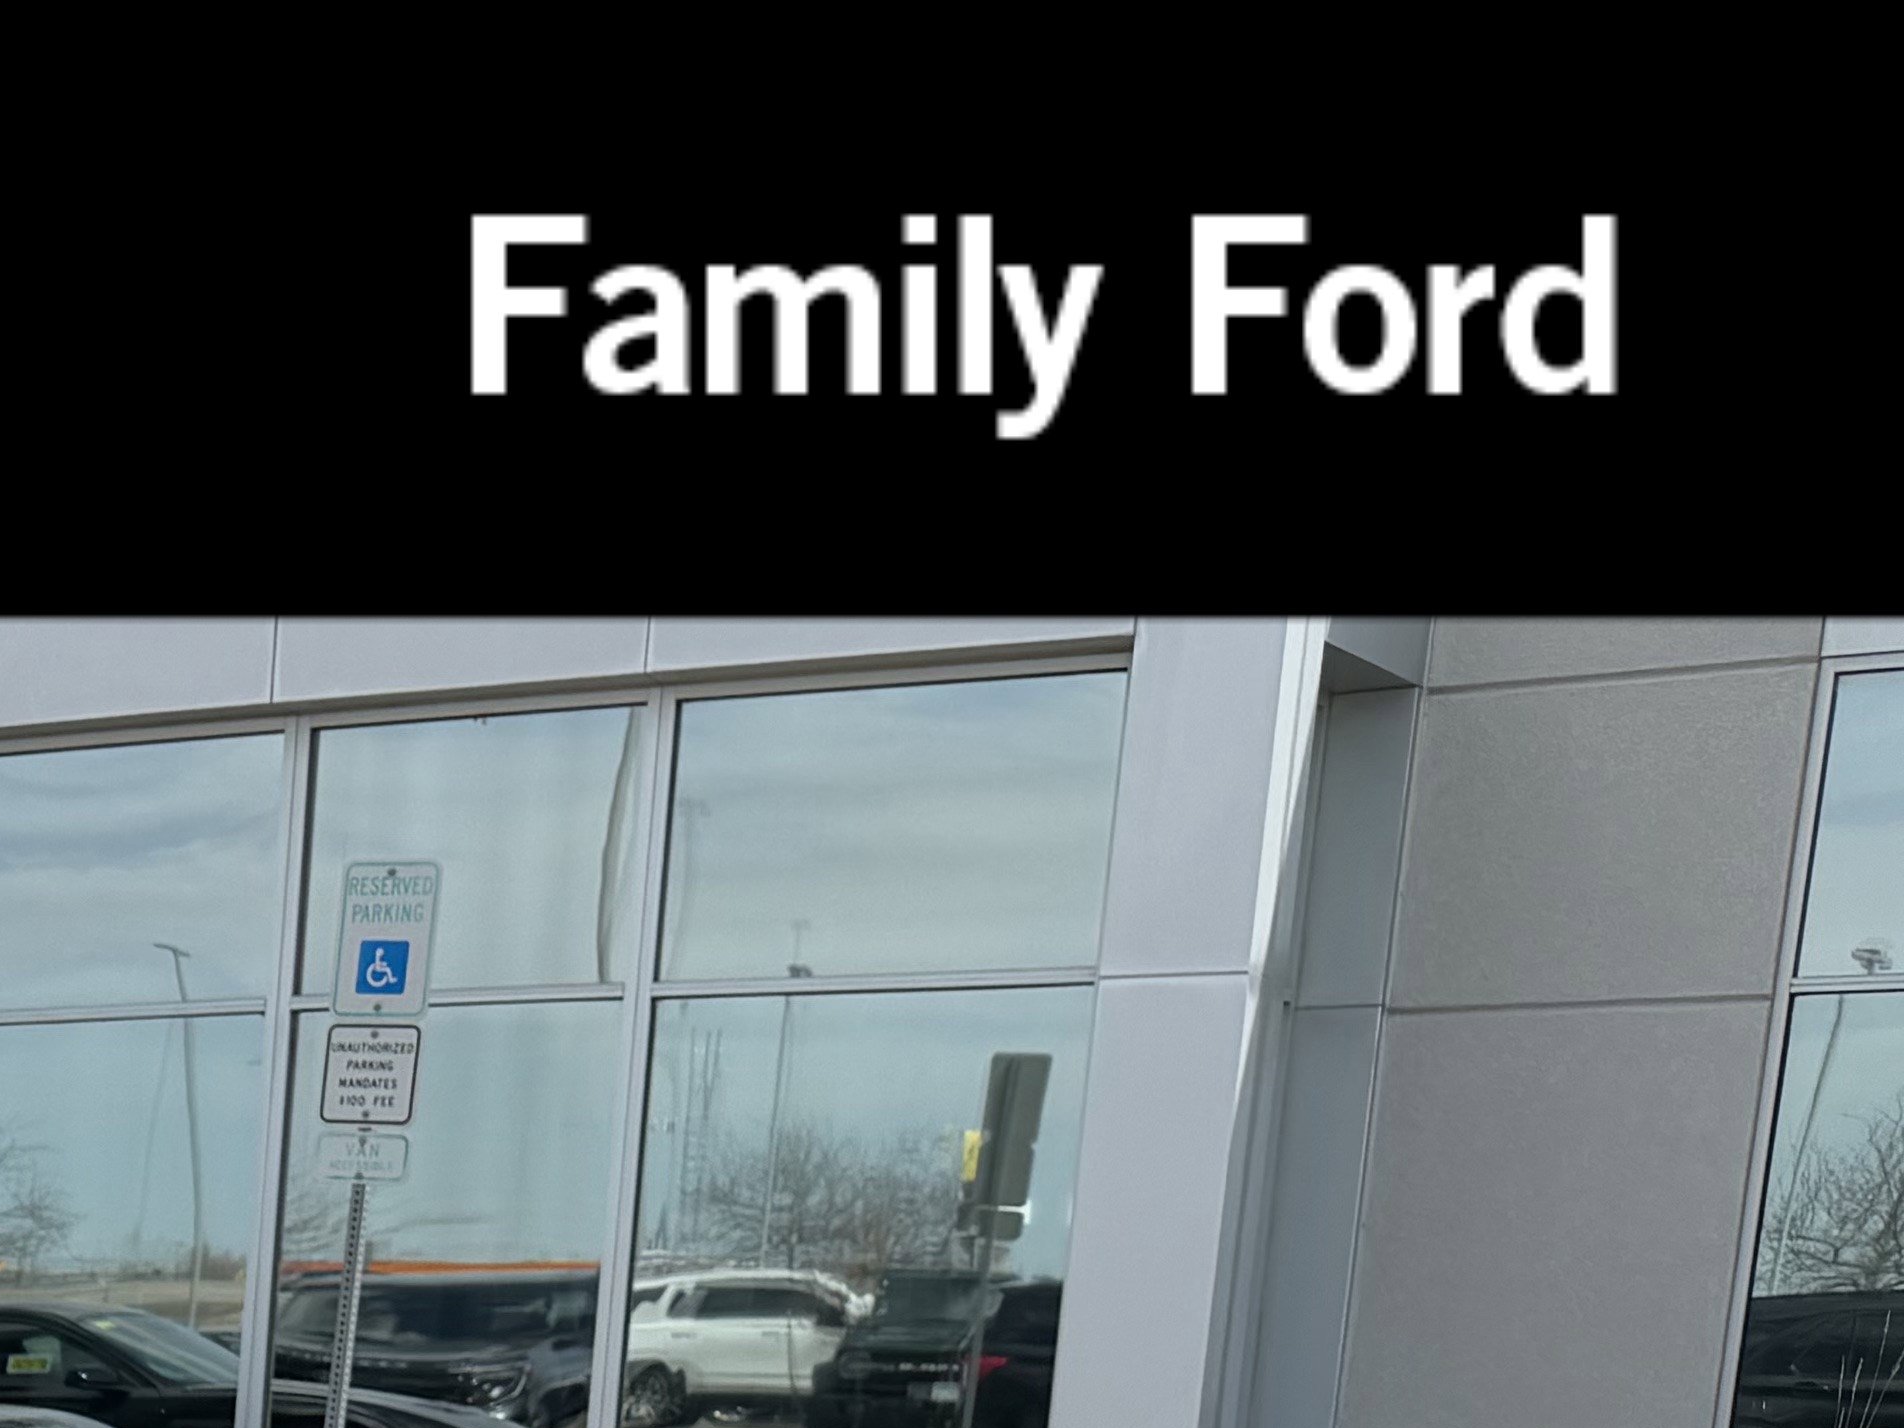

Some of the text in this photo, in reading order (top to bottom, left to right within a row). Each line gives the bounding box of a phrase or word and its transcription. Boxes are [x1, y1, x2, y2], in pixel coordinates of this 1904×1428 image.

[349, 875, 434, 897] RESERVED
[351, 903, 424, 923] PARKING
[330, 1041, 415, 1055] UNAUTHORIZED
[345, 1059, 395, 1072] PARKING
[338, 1077, 398, 1091] MANDATES
[373, 1095, 396, 1108] FEE
